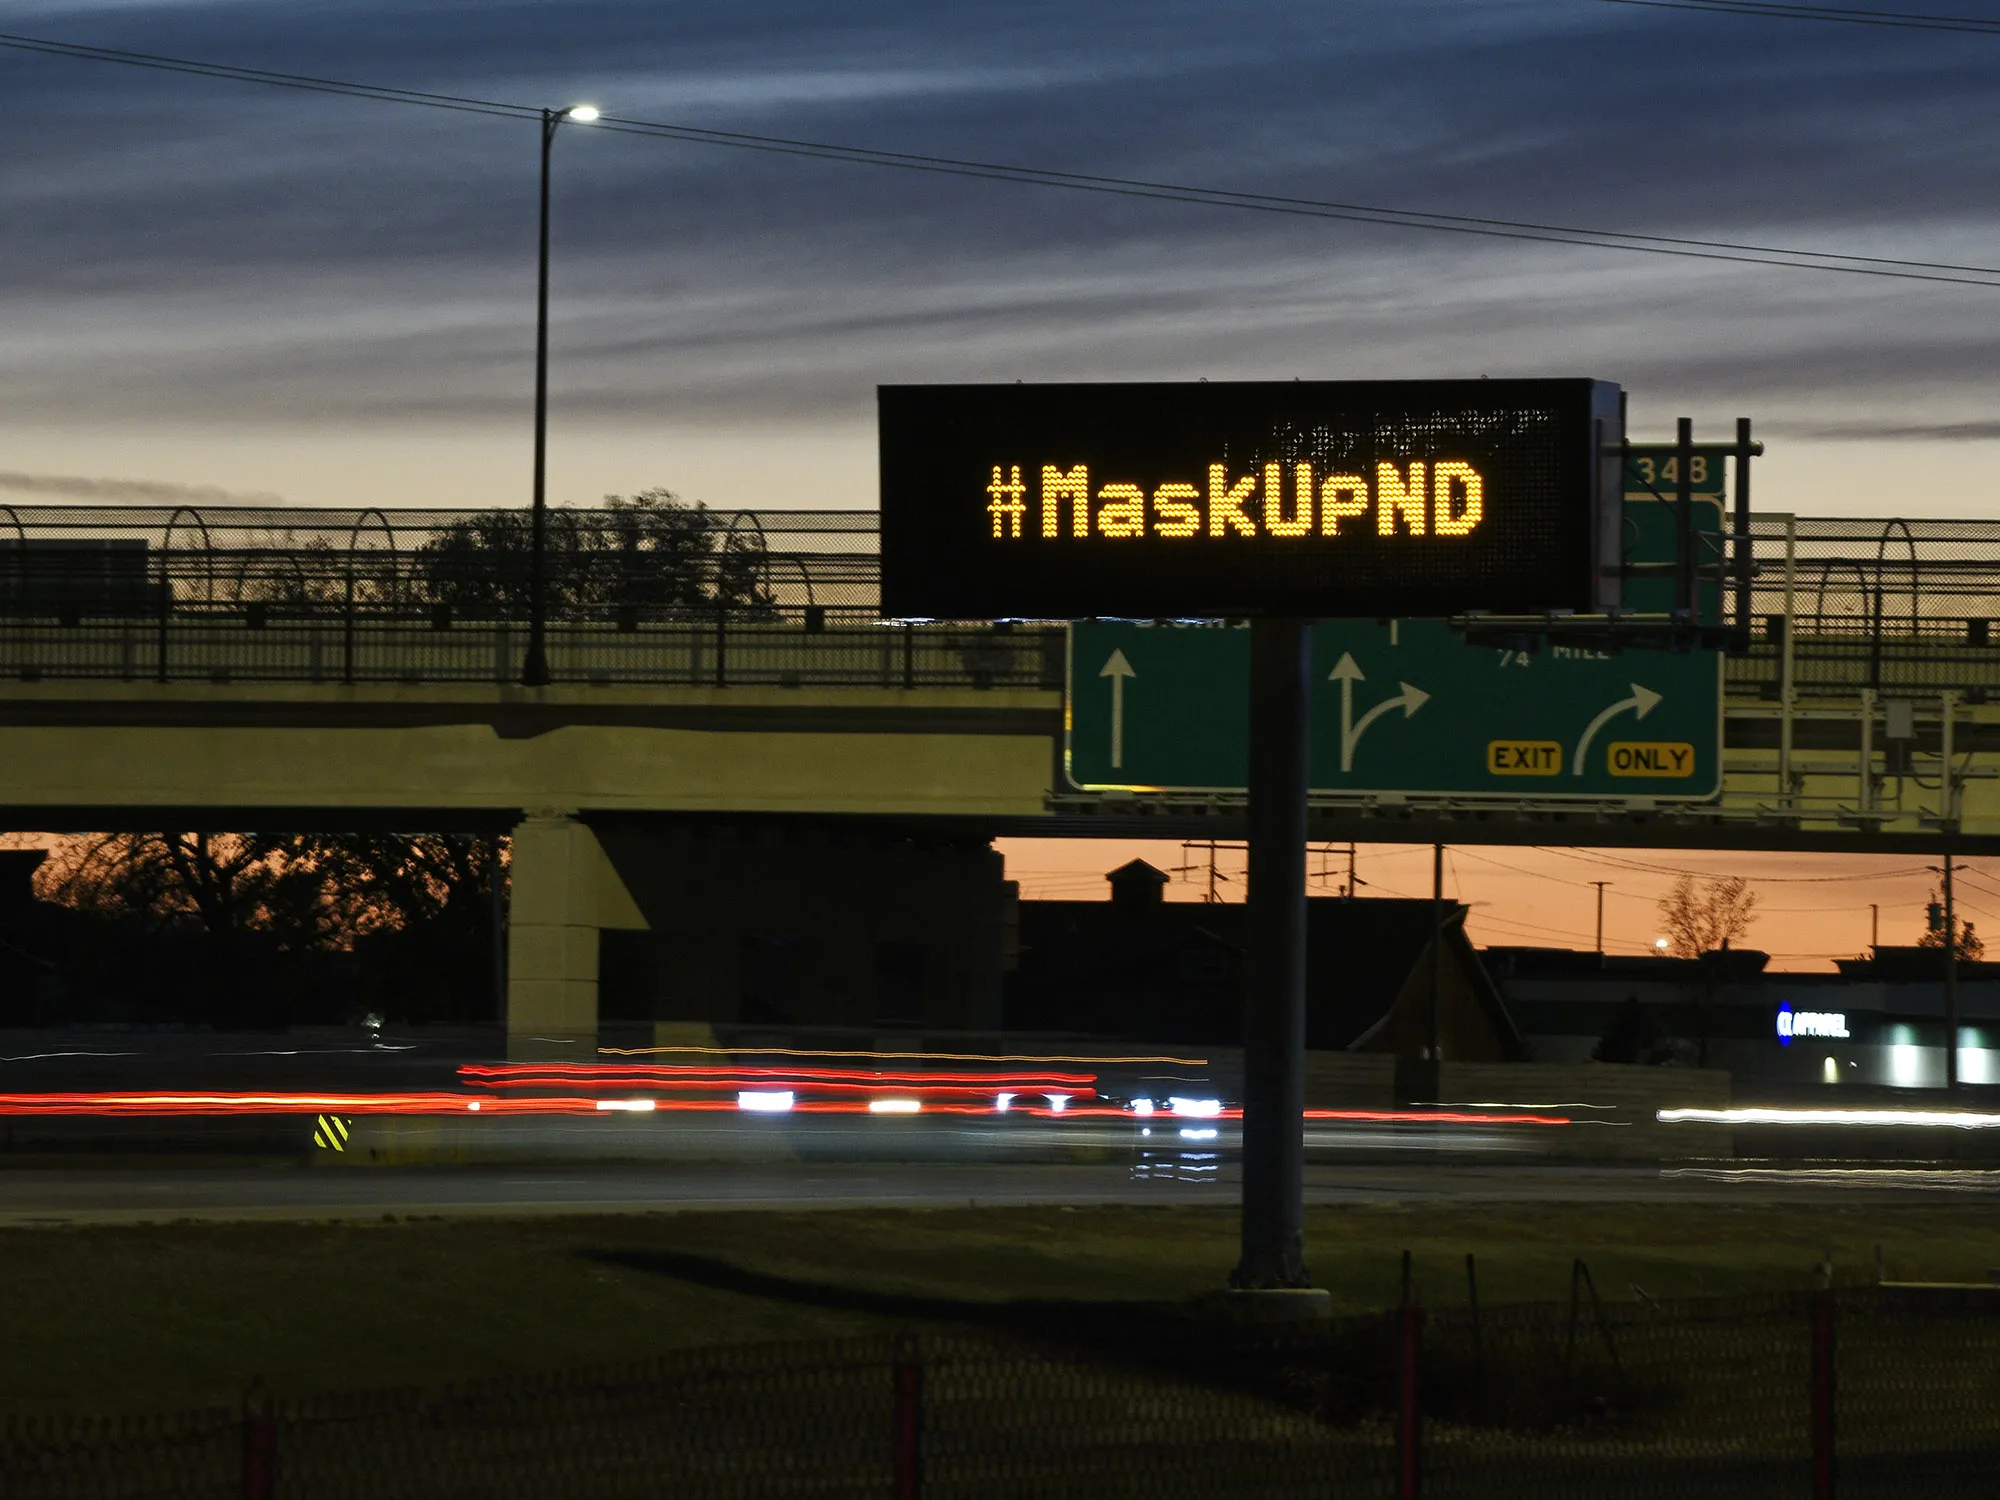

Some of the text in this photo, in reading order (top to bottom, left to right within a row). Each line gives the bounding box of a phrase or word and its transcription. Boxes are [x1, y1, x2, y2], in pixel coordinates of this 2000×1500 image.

[1636, 456, 1708, 484] 348
[986, 462, 1483, 538] #MaskUpND
[1493, 746, 1690, 771] EXIT ONLY
